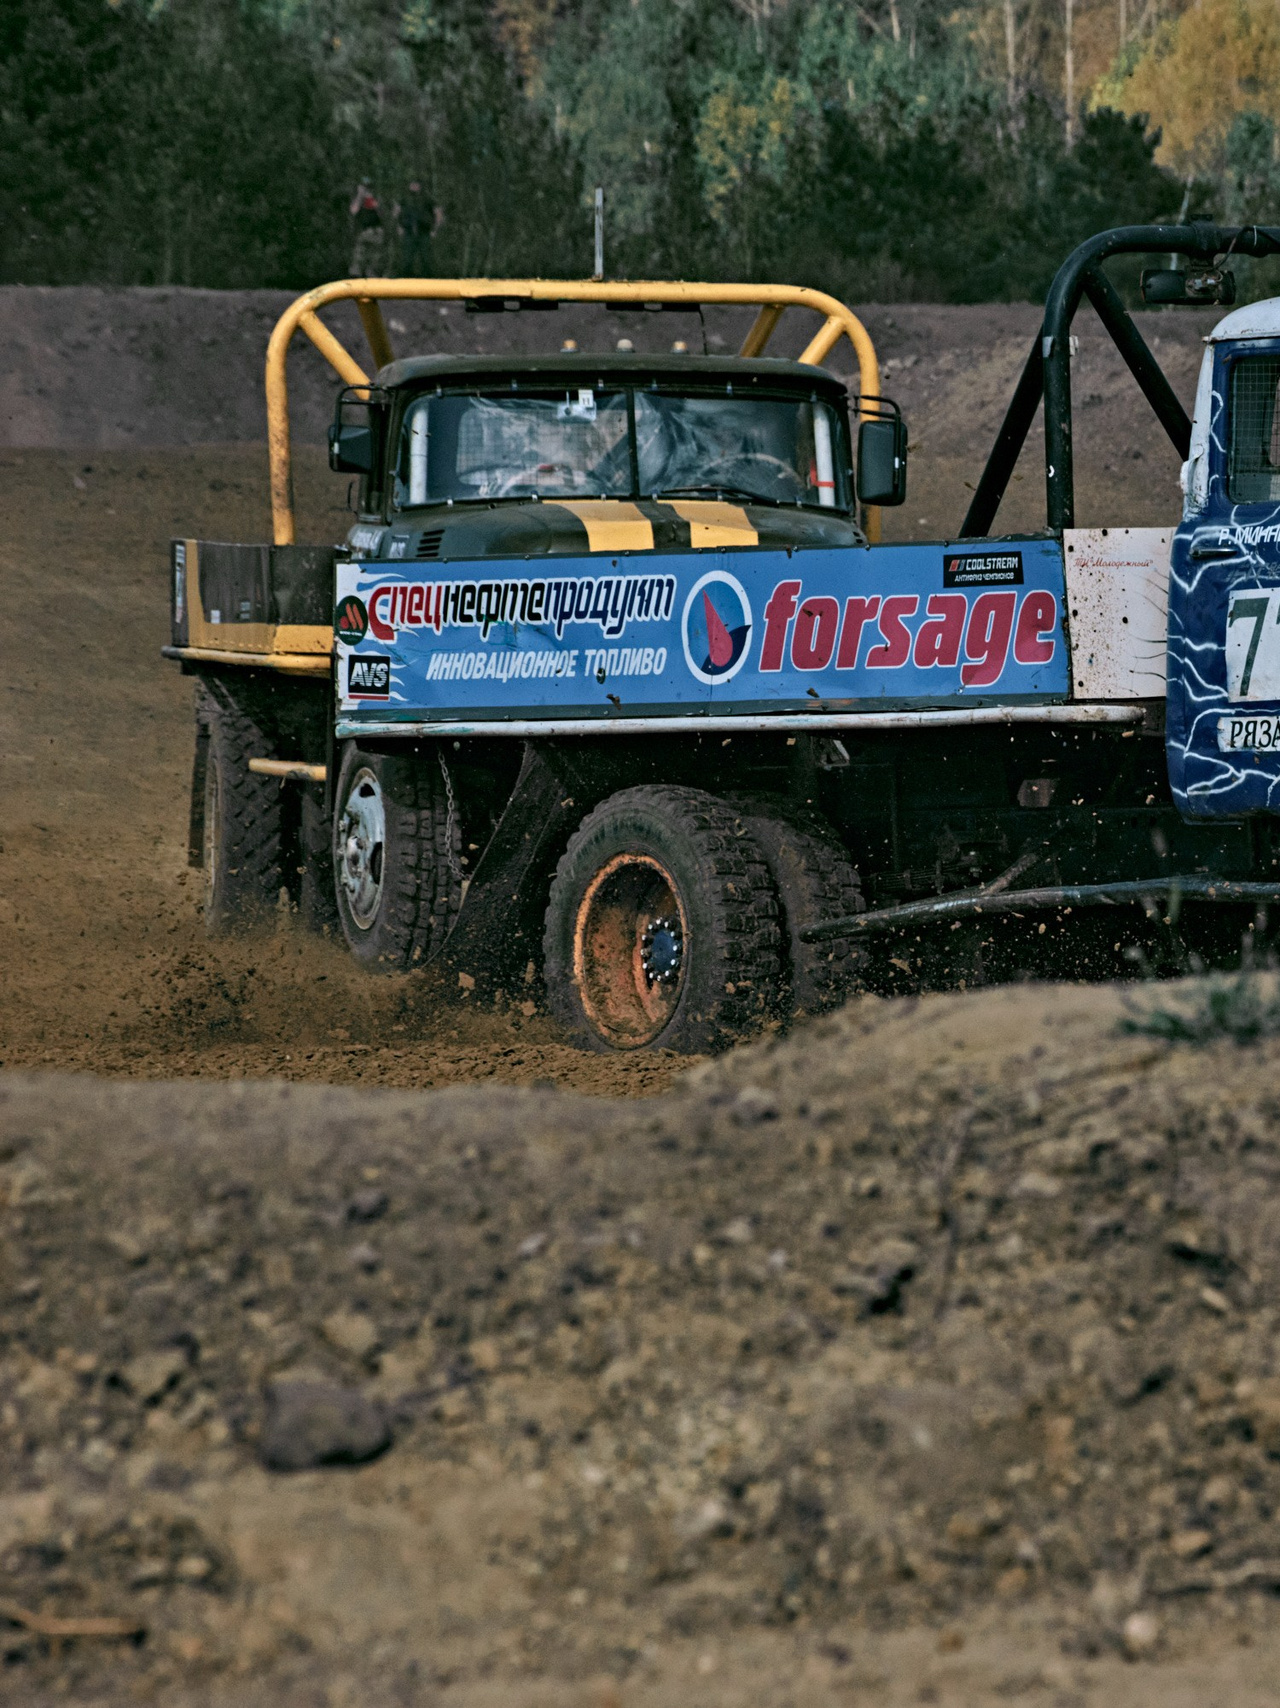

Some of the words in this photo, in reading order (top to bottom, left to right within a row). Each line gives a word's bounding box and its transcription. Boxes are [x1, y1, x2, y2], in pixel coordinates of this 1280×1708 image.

[966, 557, 1018, 571] COOLSTREAM
[758, 579, 1057, 688] forsage
[349, 662, 389, 688] AVS
[425, 649, 577, 683] ИННОВАЦИОННОЕ
[583, 648, 668, 676] ТОПЛИВО
